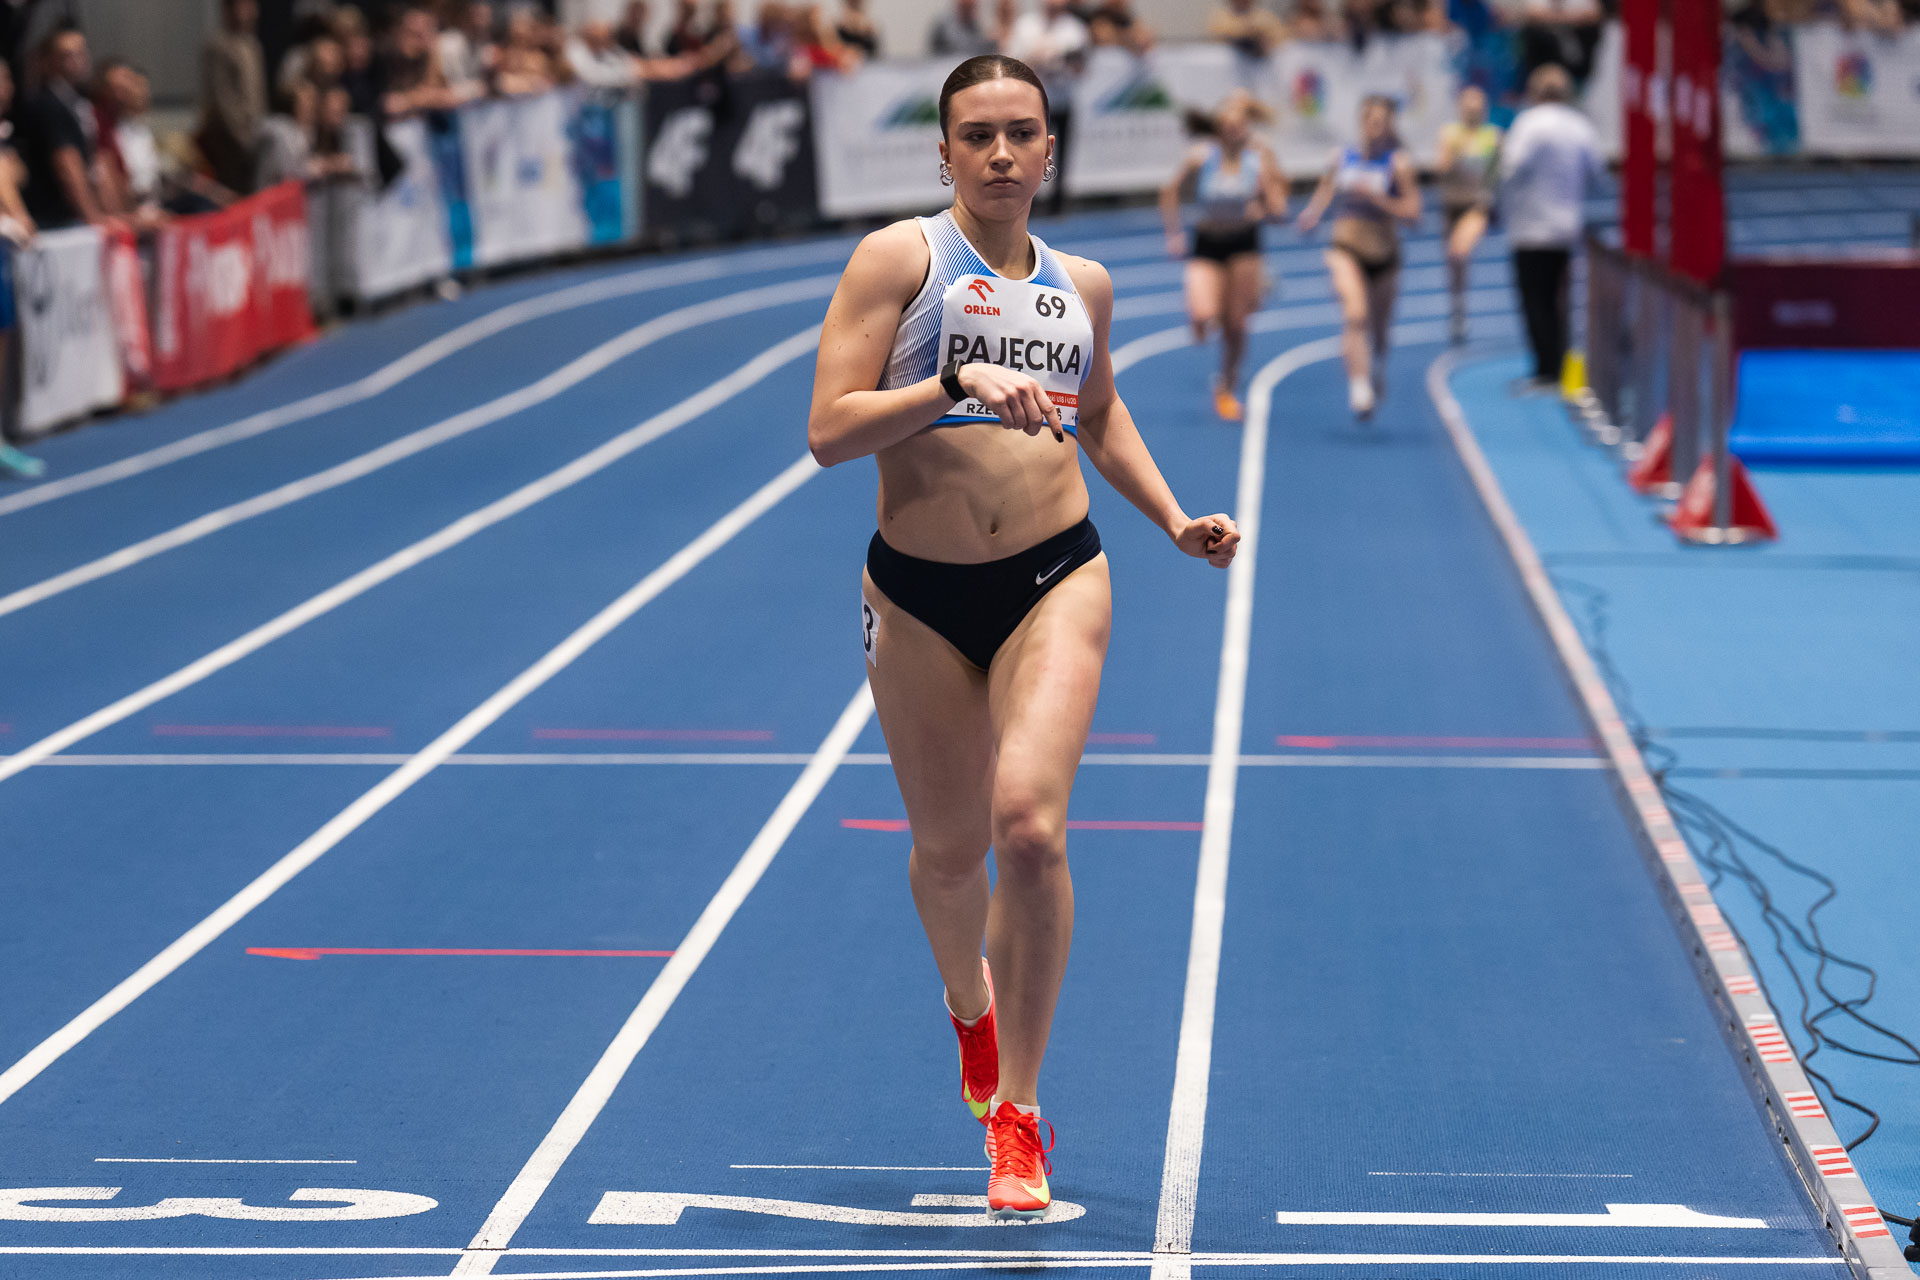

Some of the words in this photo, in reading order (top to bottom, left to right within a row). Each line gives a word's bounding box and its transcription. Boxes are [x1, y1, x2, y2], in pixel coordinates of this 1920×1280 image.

[964, 304, 1001, 316] ORLEN
[1036, 294, 1066, 319] 69
[947, 333, 1081, 375] PAJĘCKA
[863, 604, 874, 652] 3
[0, 1186, 439, 1222] 3
[588, 1191, 1086, 1227] 2
[1276, 1203, 1769, 1229] 1
